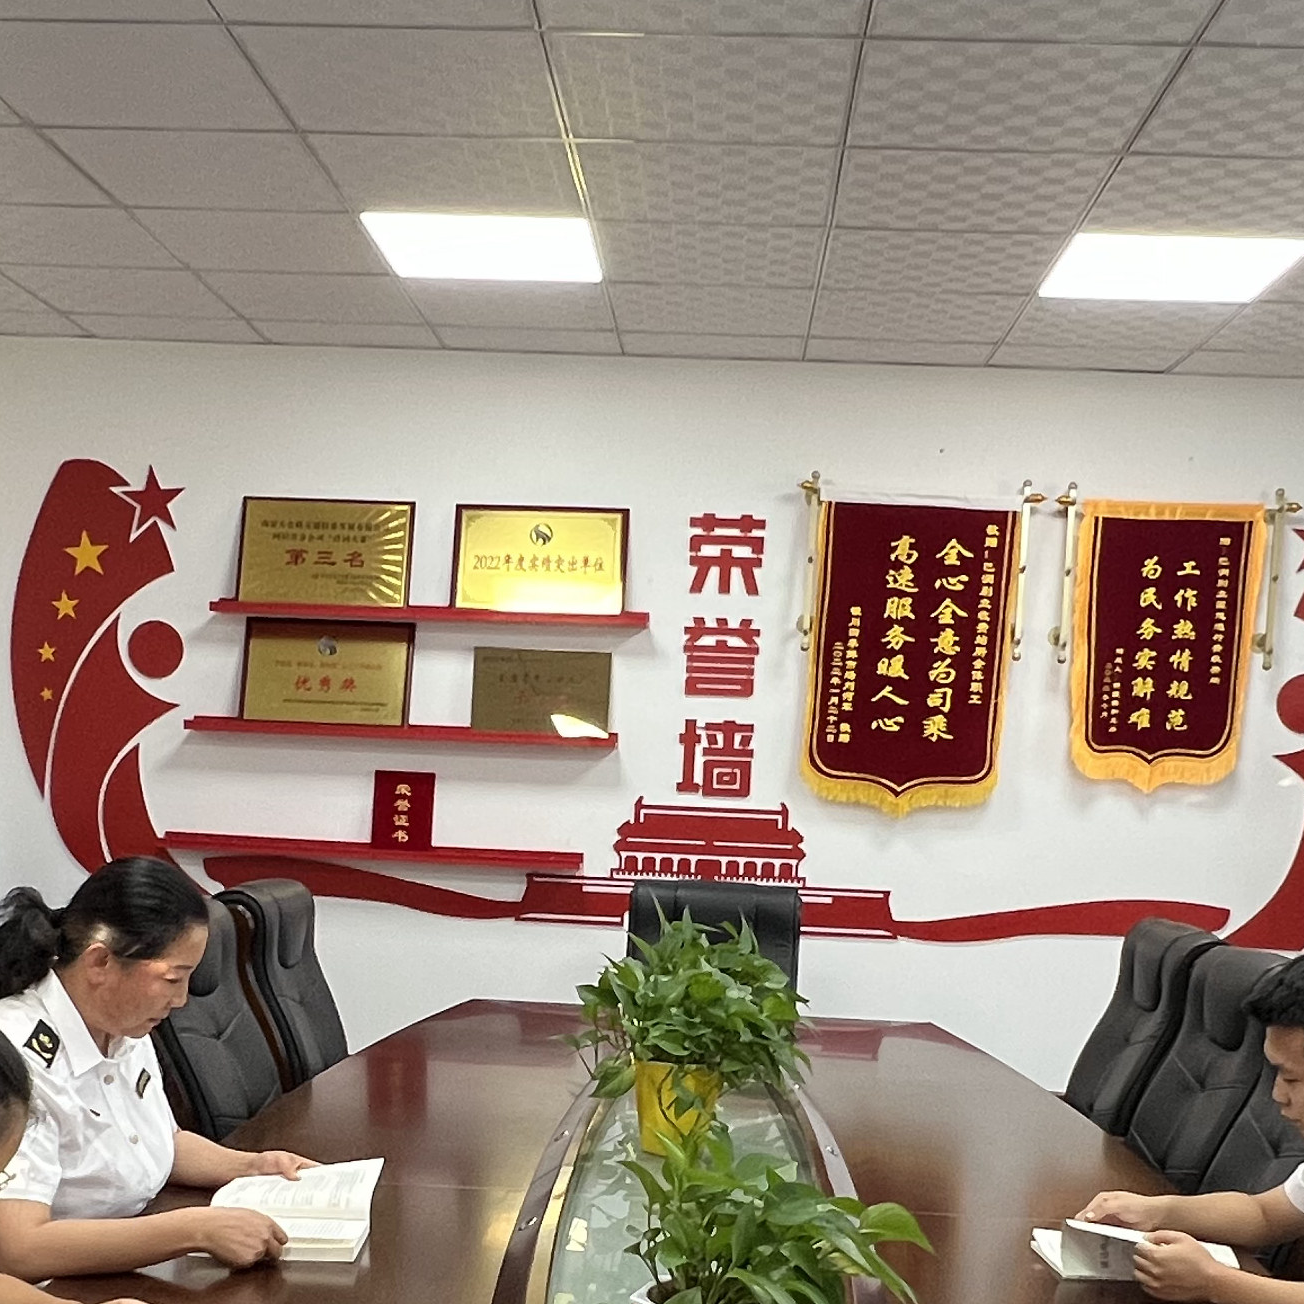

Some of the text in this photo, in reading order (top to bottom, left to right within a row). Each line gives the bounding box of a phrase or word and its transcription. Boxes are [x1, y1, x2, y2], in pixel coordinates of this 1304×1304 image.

[284, 548, 365, 568] 第三名
[921, 538, 975, 742] 全心全意为司乘
[1165, 560, 1201, 732] 工作热情规范
[675, 512, 767, 800] 荣誉墙
